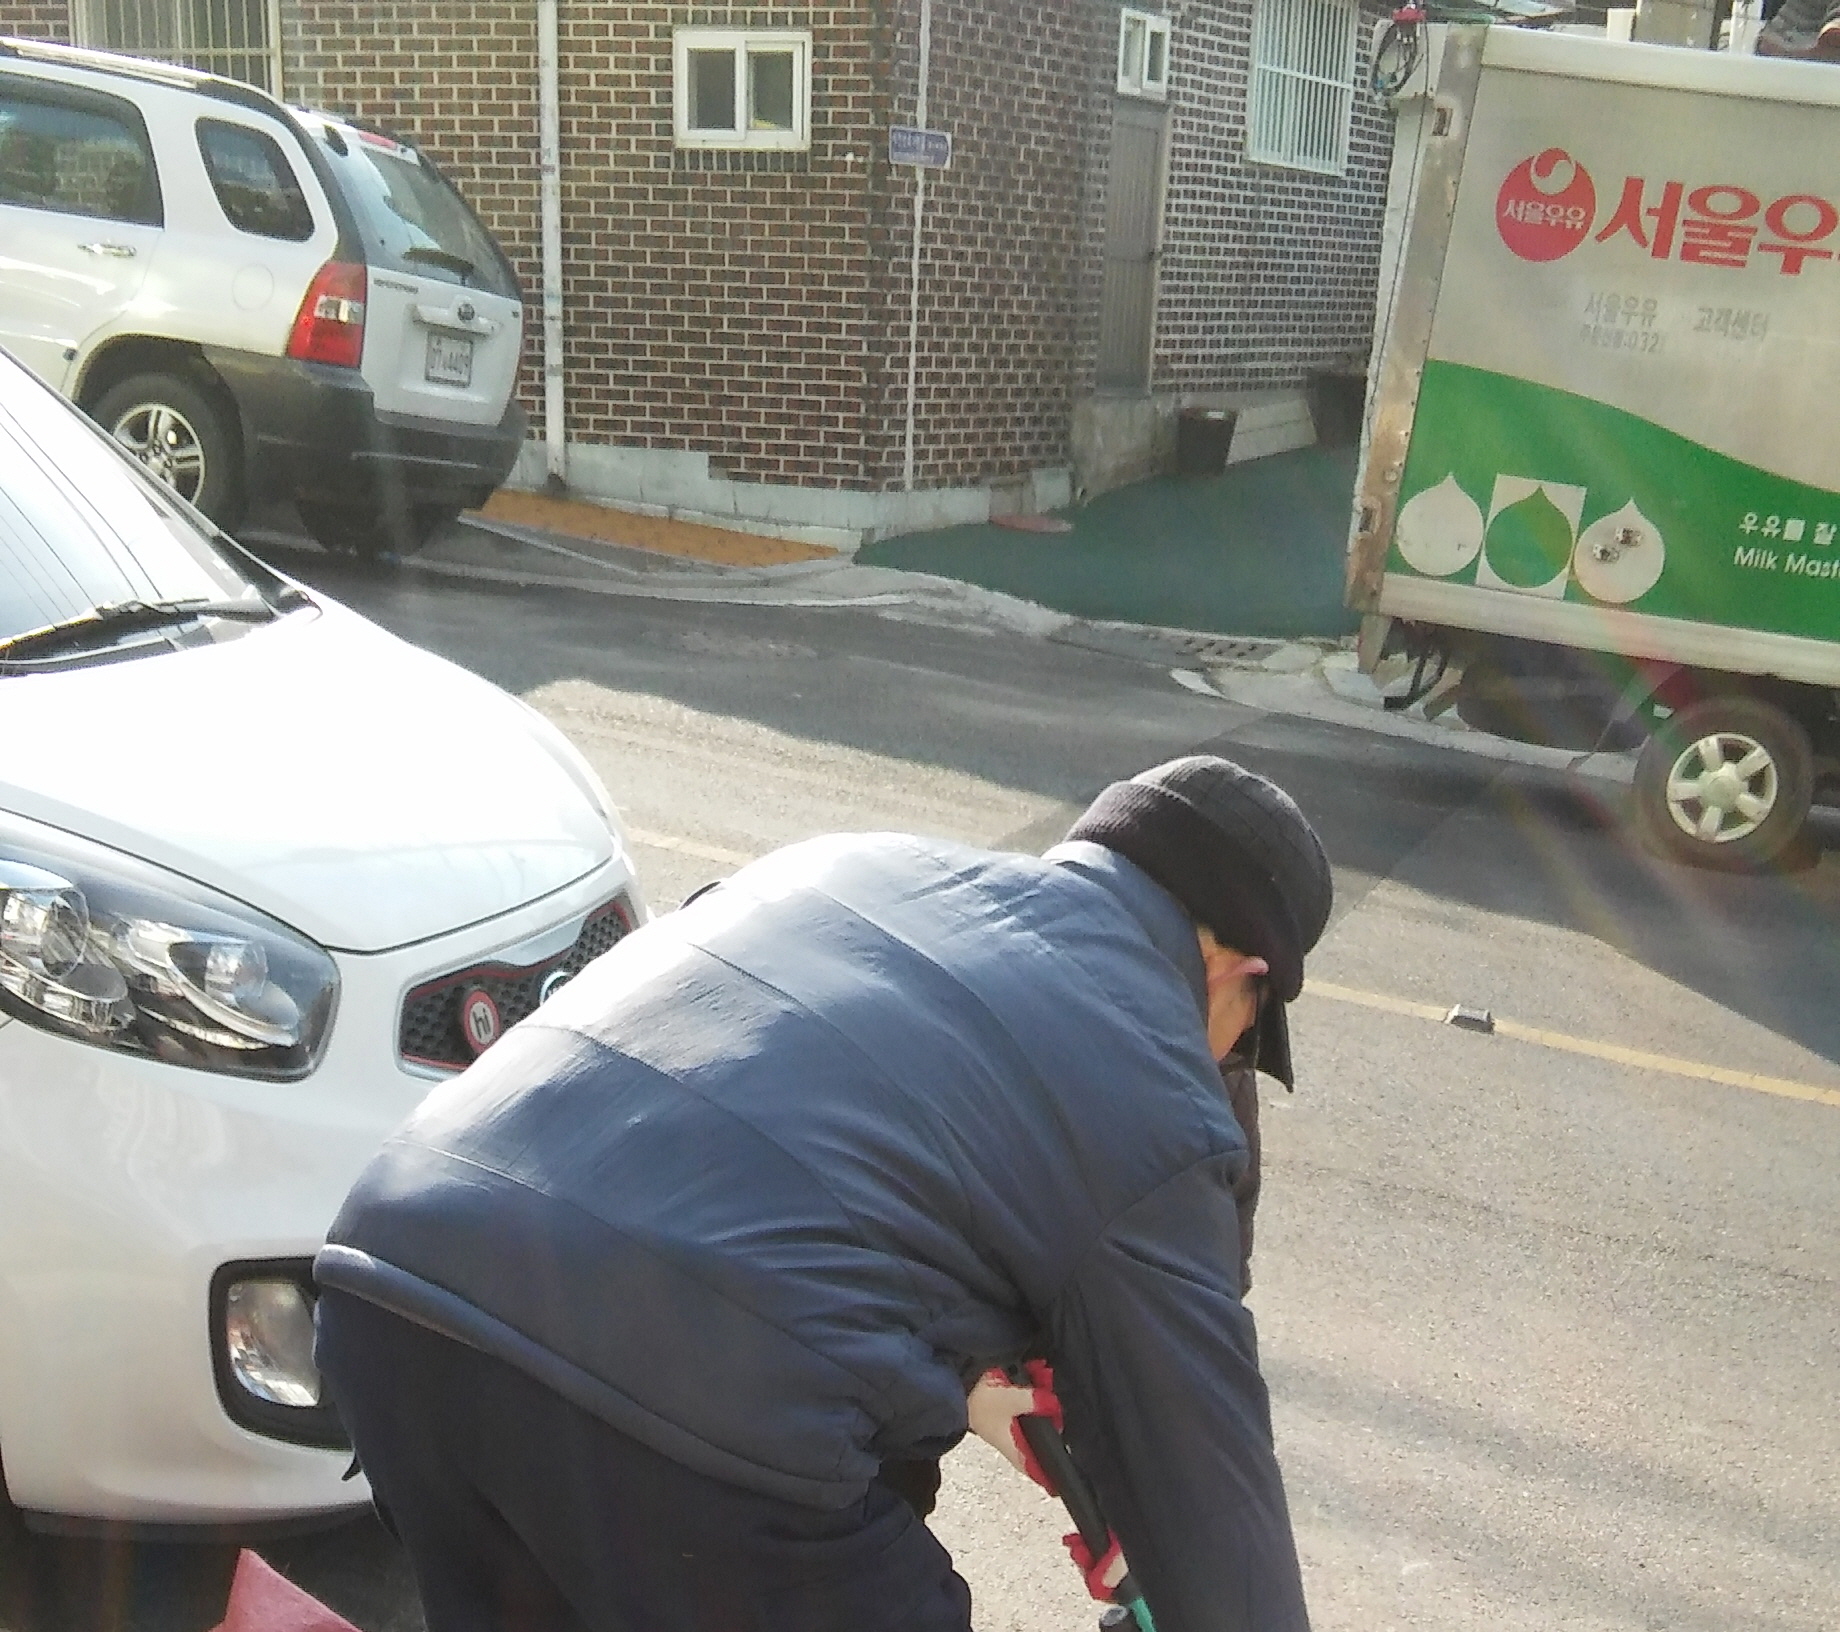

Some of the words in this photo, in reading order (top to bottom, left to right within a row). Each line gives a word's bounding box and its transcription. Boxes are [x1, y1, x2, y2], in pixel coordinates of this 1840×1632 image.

[1503, 199, 1587, 230] 서울우유
[1595, 175, 1840, 275] 서울우
[1584, 292, 1658, 328] 서울우유
[1693, 307, 1771, 343] 고객센터
[1733, 546, 1779, 571] Milk
[1784, 552, 1840, 578] Mast
